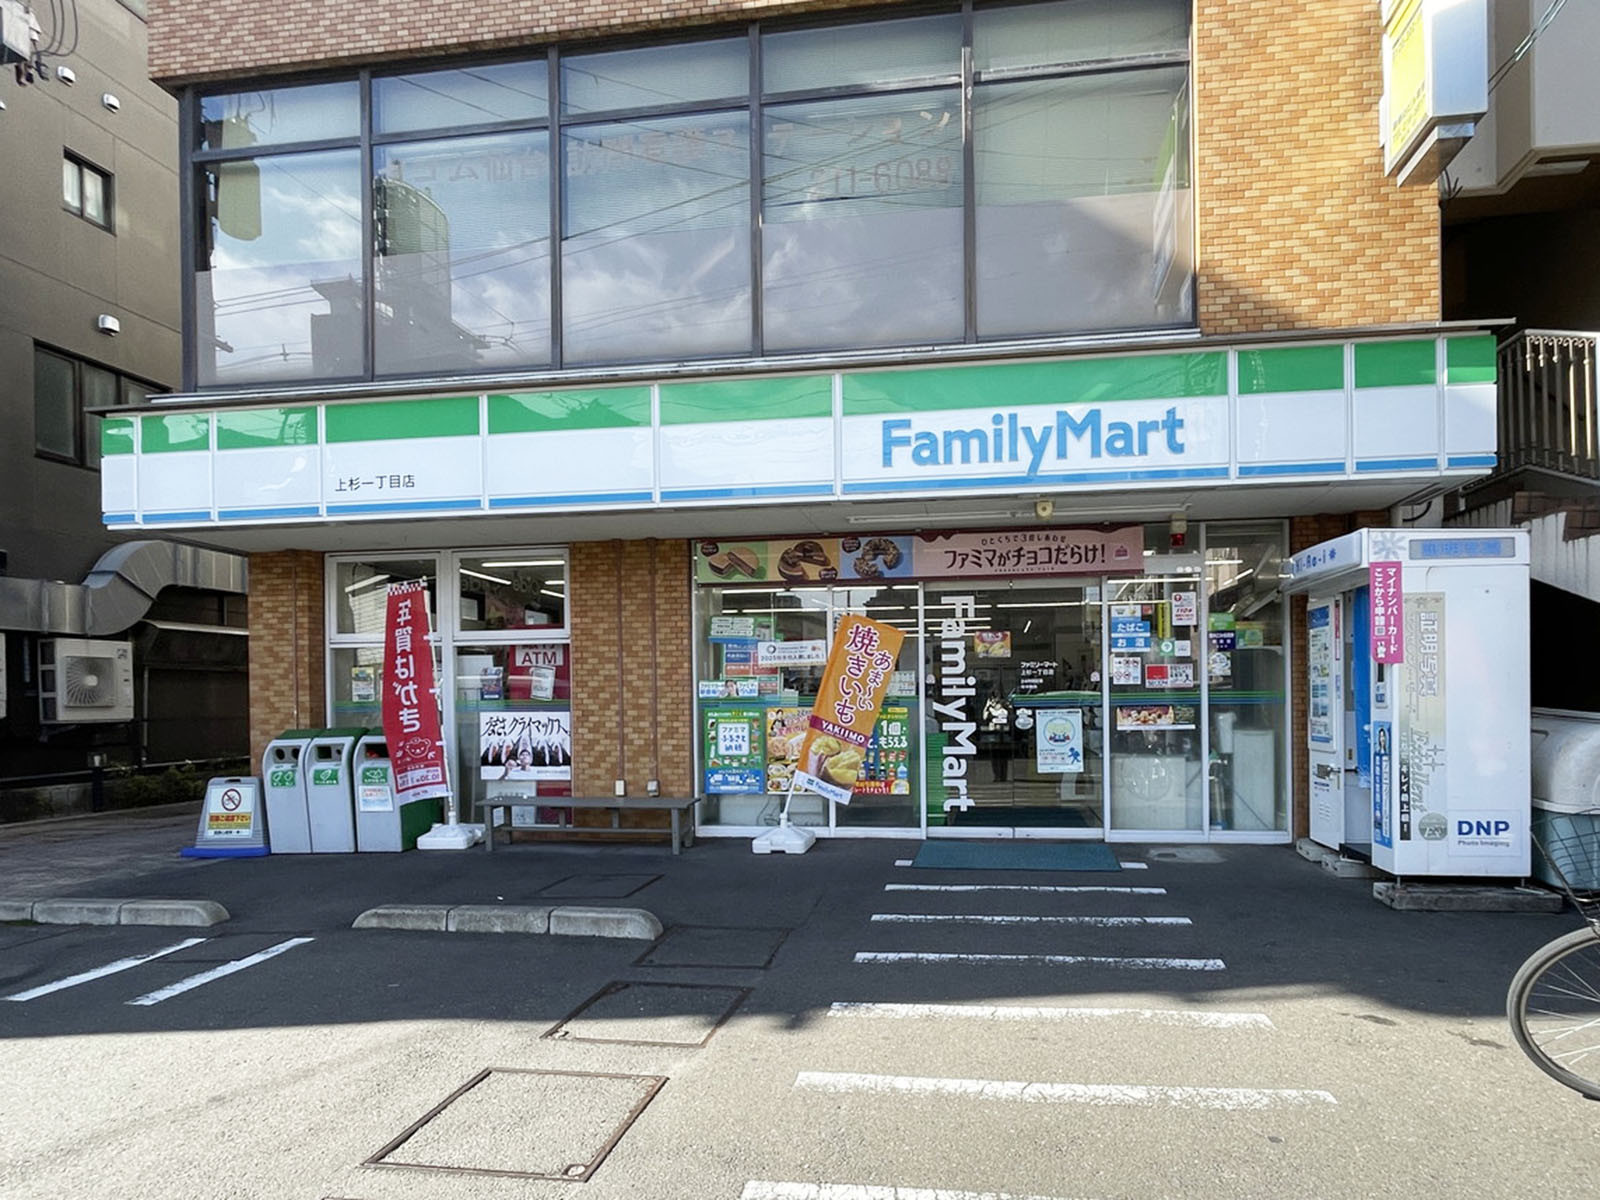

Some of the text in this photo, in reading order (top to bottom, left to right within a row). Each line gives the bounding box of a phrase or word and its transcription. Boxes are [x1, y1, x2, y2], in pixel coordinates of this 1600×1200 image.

[882, 407, 1185, 477] FamilyMart
[335, 474, 415, 491] 上杉一丁目店
[1387, 567, 1398, 655] マイナンバーカード
[1116, 622, 1145, 633] たばこ
[521, 652, 557, 665] ATM
[835, 623, 881, 726] 焼きいも
[932, 595, 977, 812] FamilyMart
[821, 719, 865, 744] YAKIIMO
[1457, 820, 1510, 836] DNP
[1479, 840, 1510, 848] Imaging
